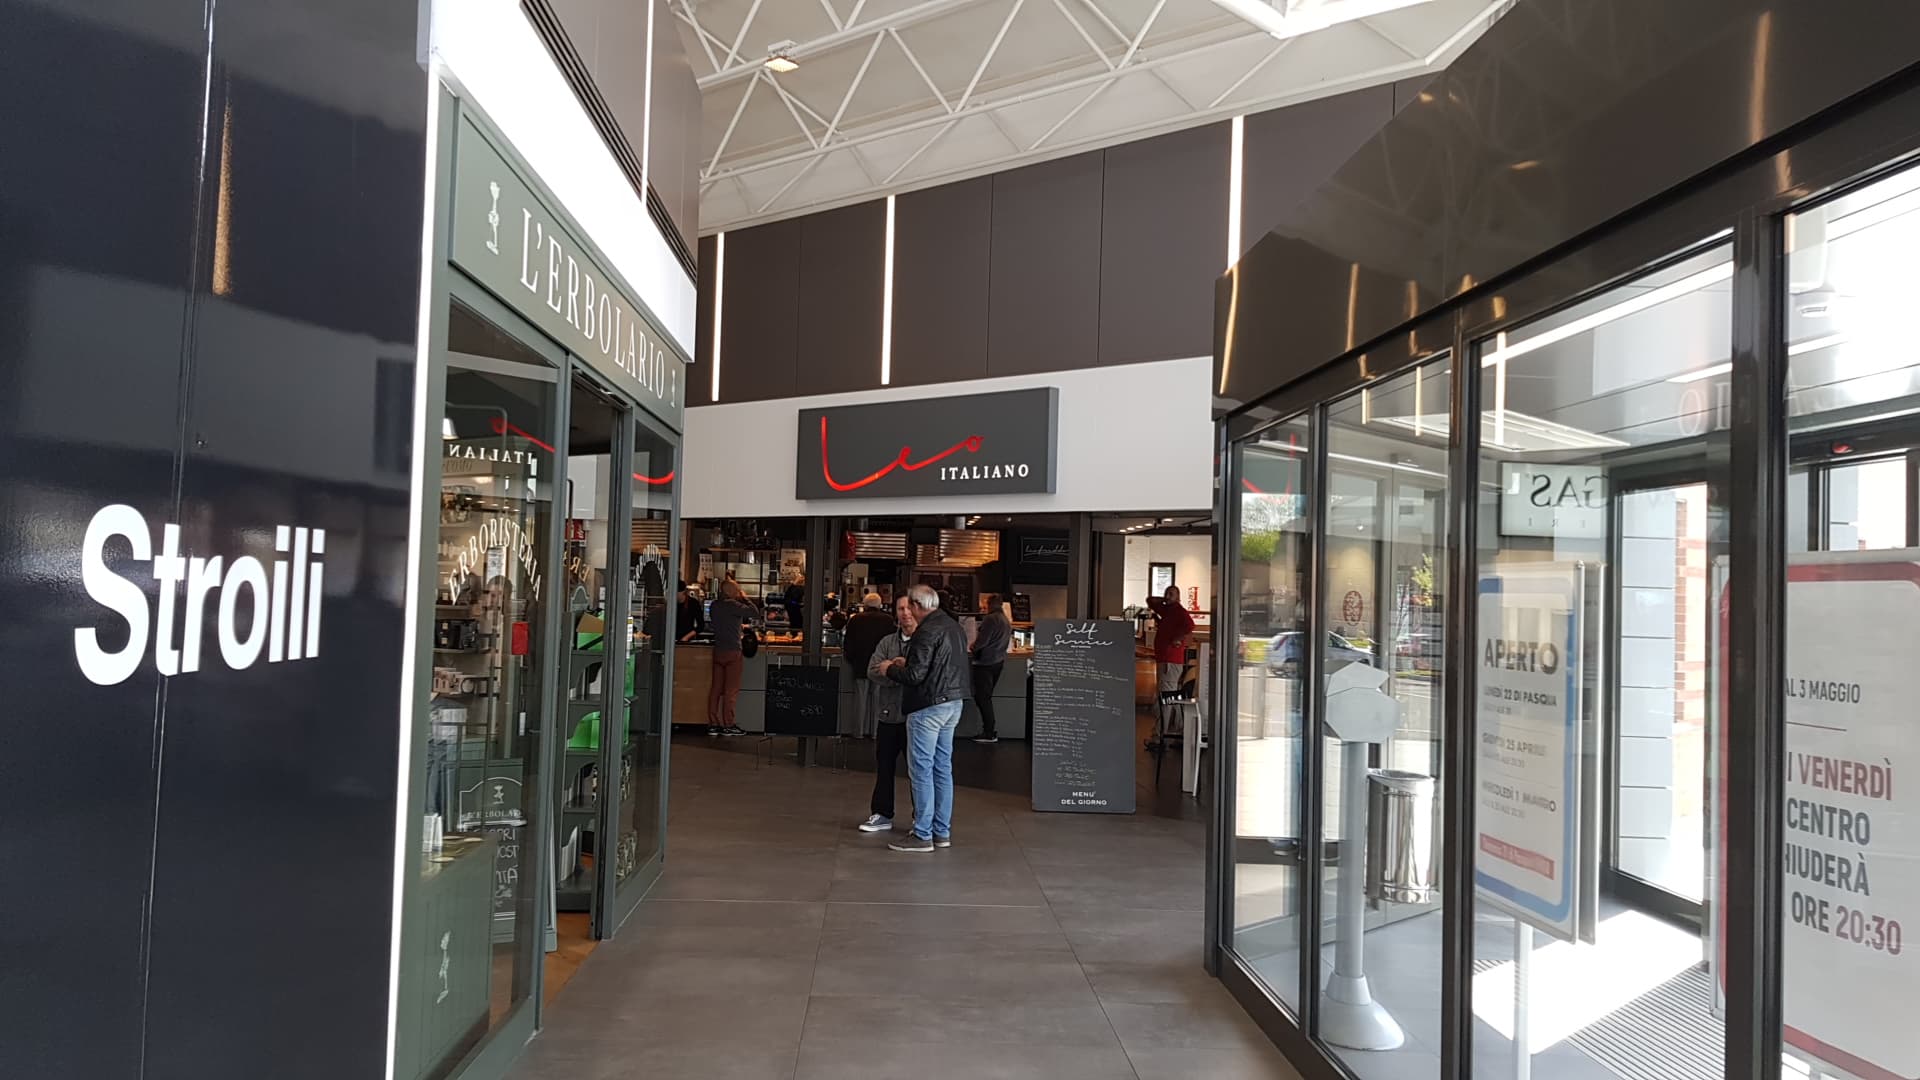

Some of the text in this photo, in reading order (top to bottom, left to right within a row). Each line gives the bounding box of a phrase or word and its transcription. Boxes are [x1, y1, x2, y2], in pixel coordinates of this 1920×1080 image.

[520, 207, 665, 399] L'ERBOLARIO
[820, 415, 985, 492] Leo
[940, 463, 1030, 481] ITALIANO
[449, 517, 542, 606] ERBORISTERIA
[74, 503, 325, 685] Stroili
[1484, 638, 1558, 675] APERTO
[1799, 679, 1806, 699] 3
[1809, 680, 1861, 704] MAGGIO
[1798, 753, 1892, 801] VENERDÌ
[1786, 797, 1871, 846] CENTRO
[1791, 891, 1902, 956] ORE 20:30
